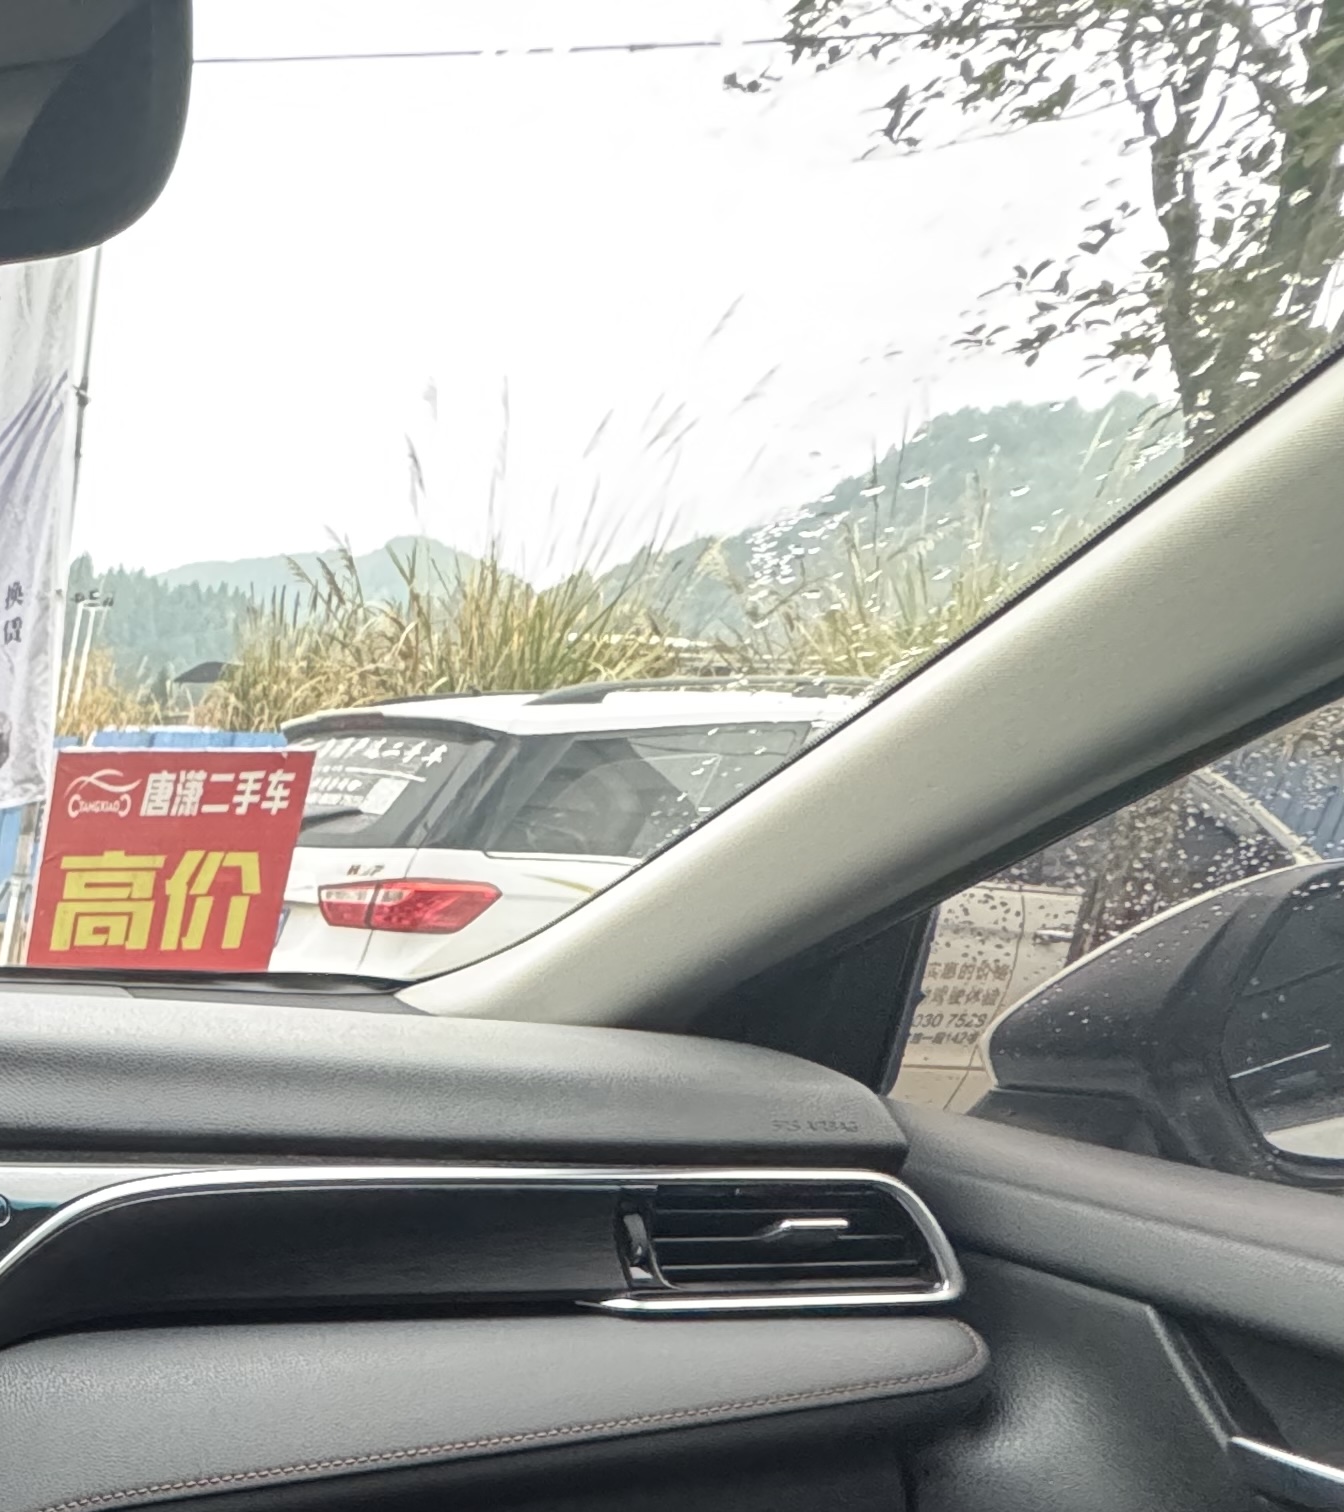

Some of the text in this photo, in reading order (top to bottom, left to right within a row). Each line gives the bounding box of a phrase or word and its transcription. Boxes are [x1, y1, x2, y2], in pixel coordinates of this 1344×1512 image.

[139, 769, 296, 817] 唐潇二手车
[49, 850, 262, 951] 高价
